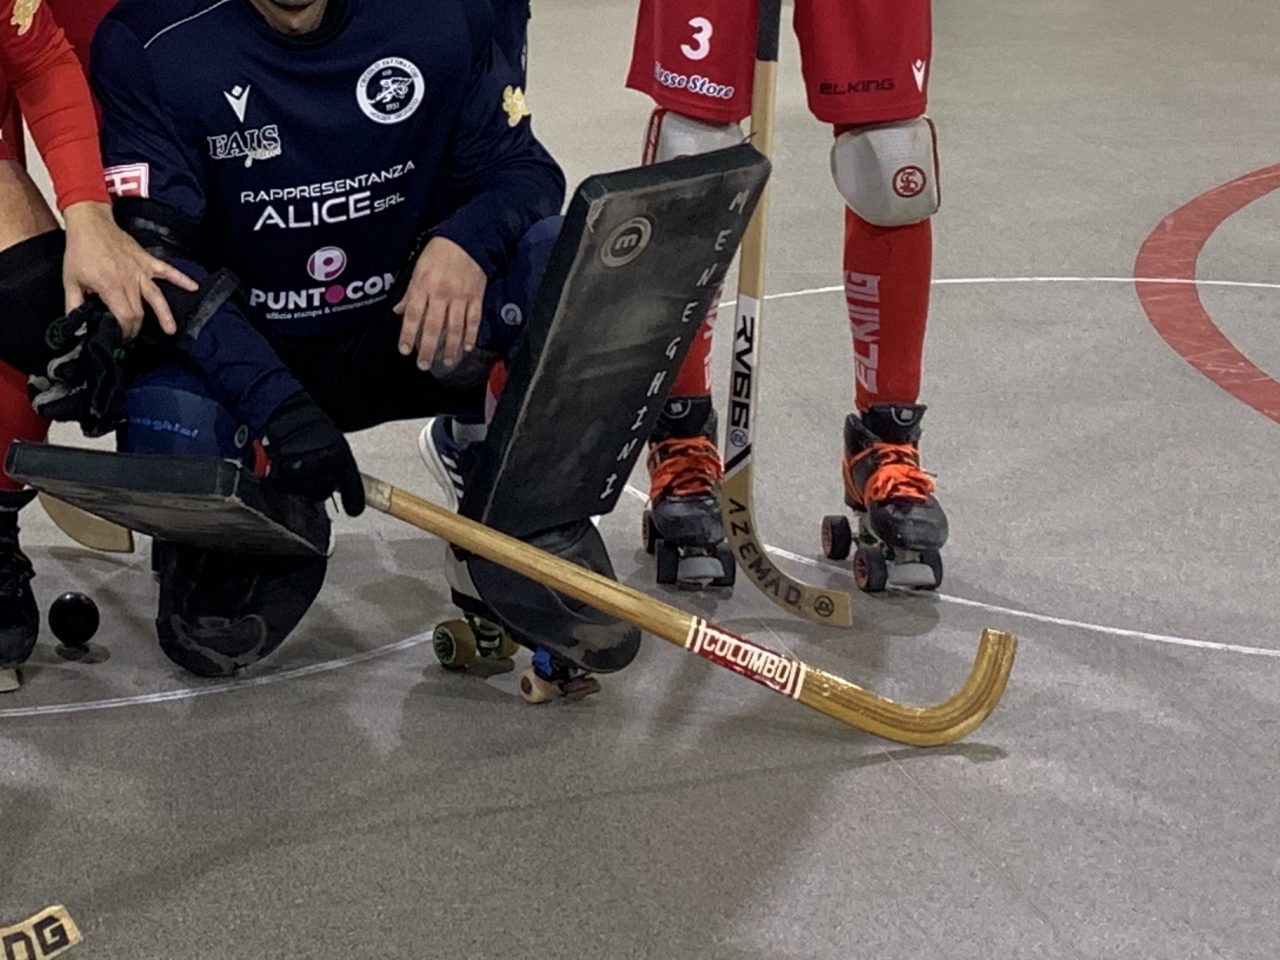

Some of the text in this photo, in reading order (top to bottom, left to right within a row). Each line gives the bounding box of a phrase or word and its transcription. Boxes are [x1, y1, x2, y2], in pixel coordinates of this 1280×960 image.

[680, 17, 713, 61] 3
[687, 74, 734, 100] Store
[241, 160, 415, 203] RAPPRESENTANZA
[253, 191, 405, 231] ALICE SRL
[701, 627, 791, 685] COLOMBO
